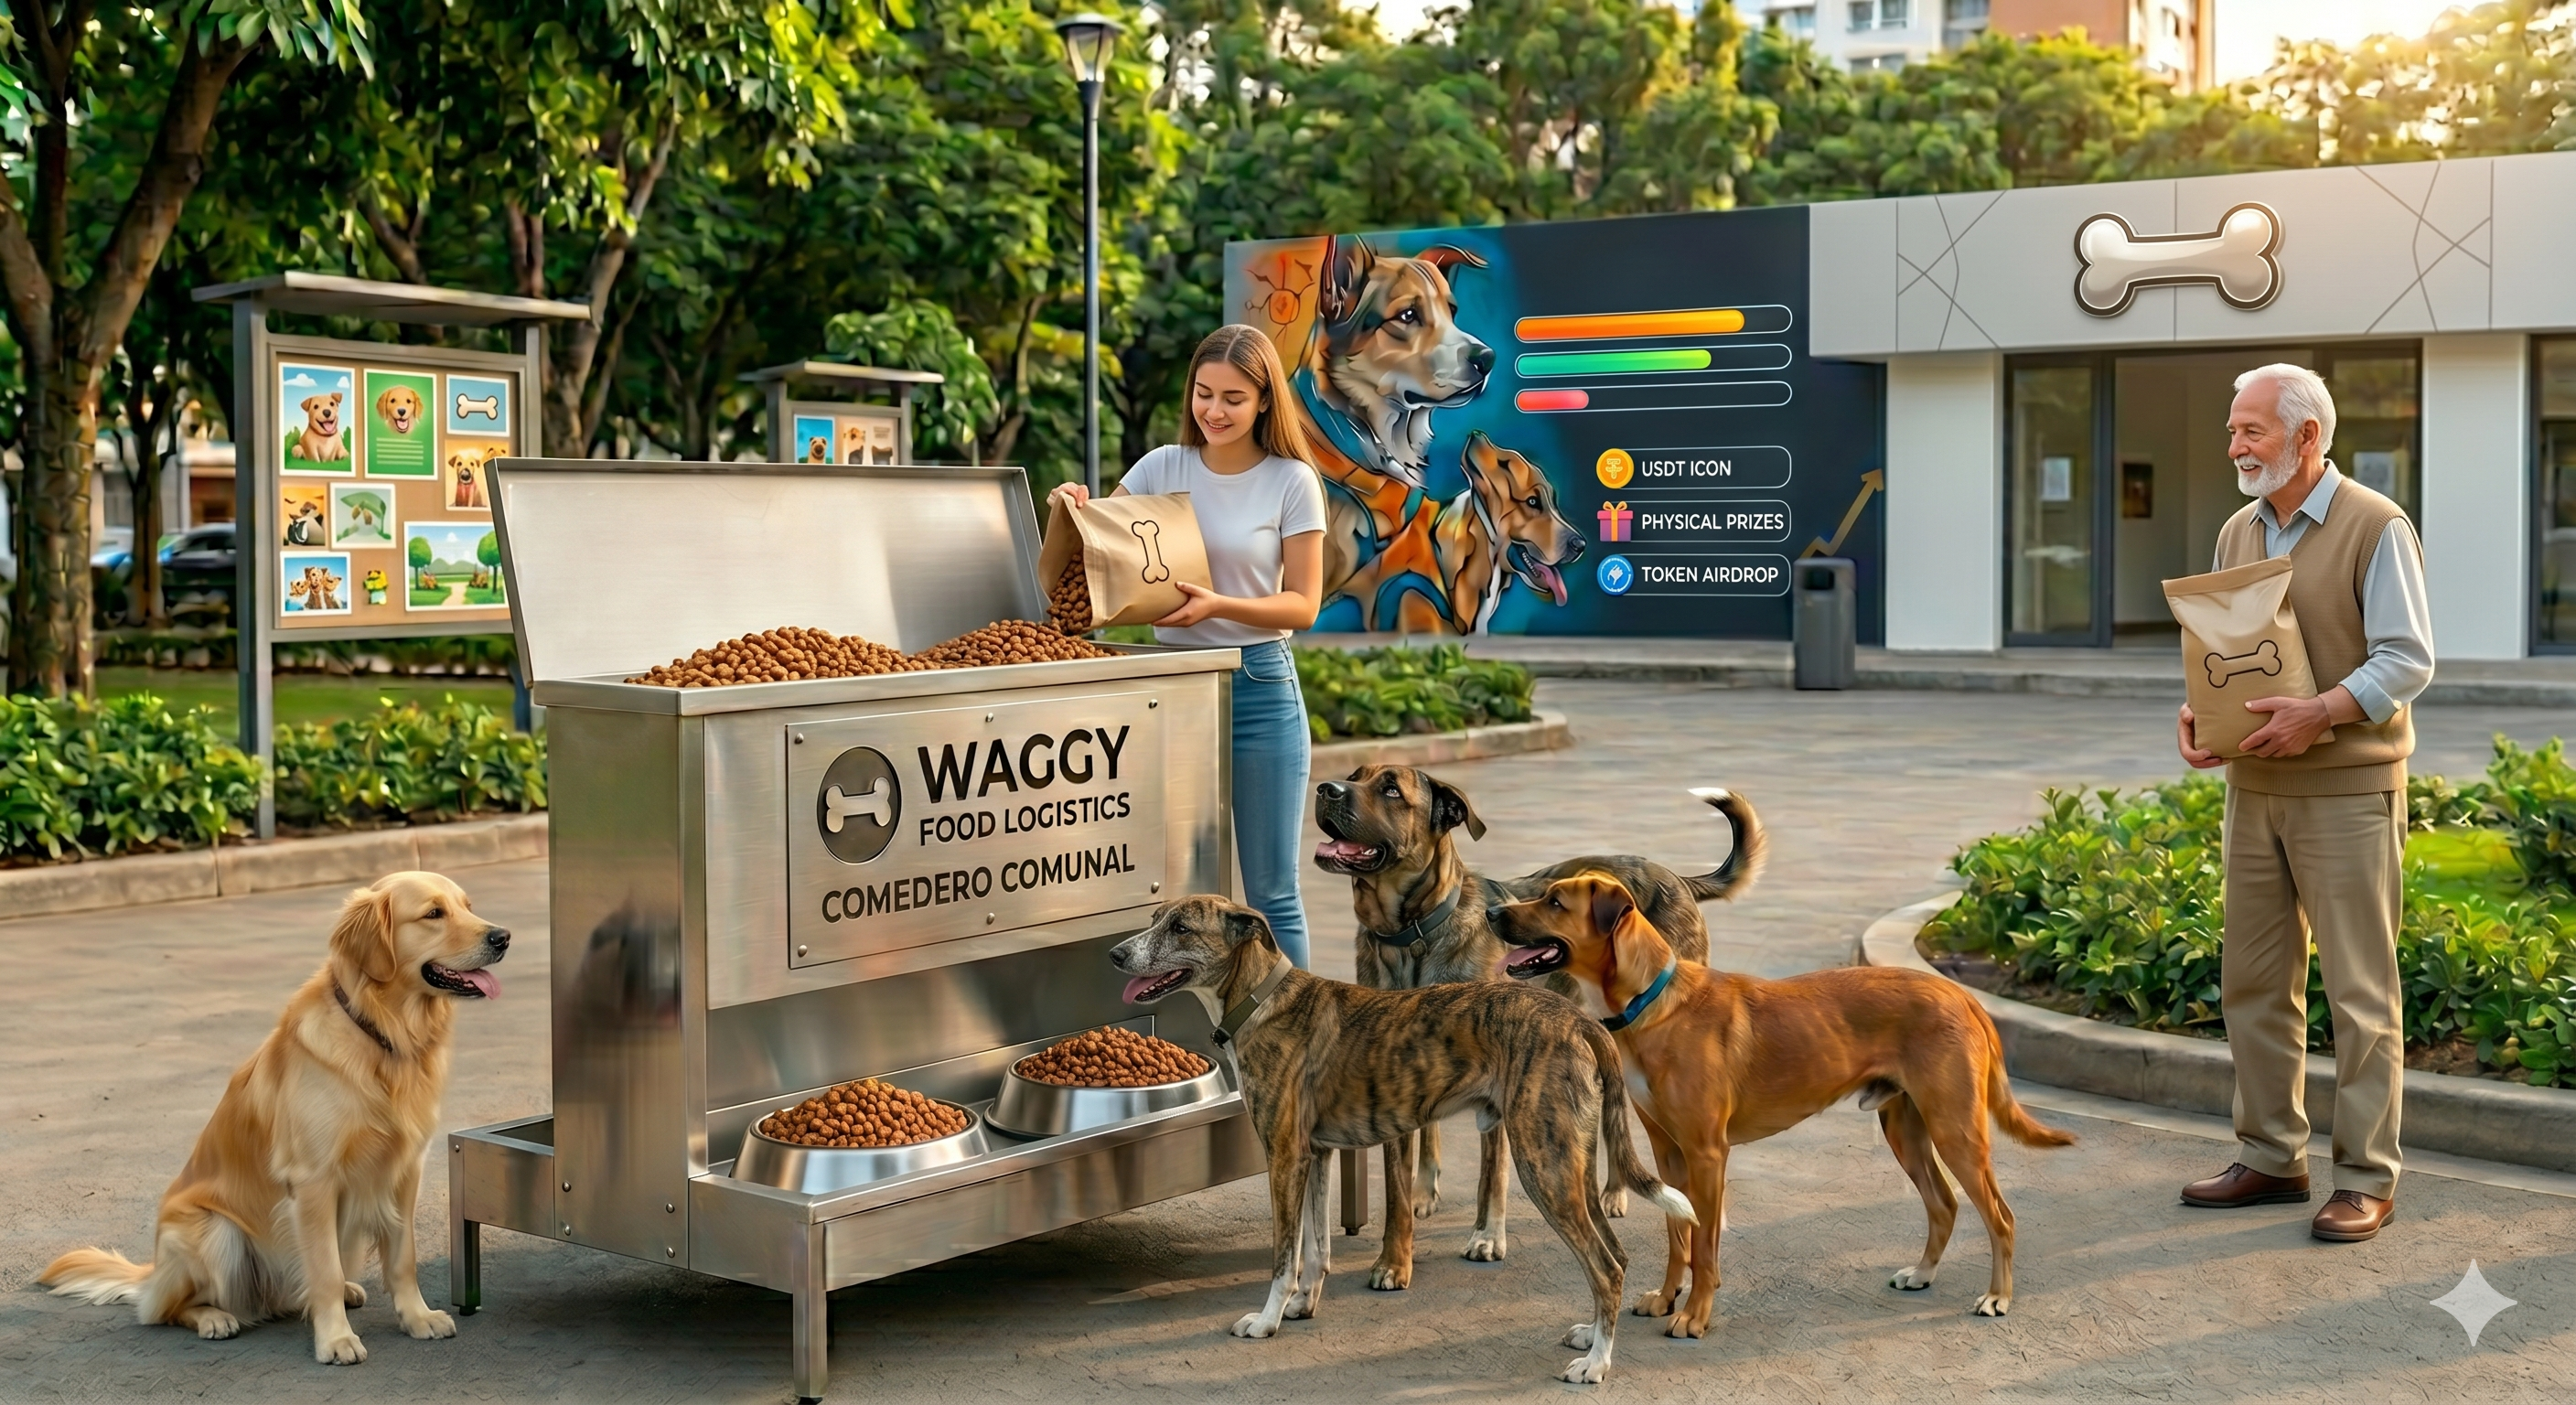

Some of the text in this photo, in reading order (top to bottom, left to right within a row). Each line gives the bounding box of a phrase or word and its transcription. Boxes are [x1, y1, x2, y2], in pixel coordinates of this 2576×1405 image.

[1642, 459, 1732, 477] USDT ICON
[1642, 513, 1785, 531] PHYSICAL PRIZES
[1641, 566, 1779, 584] TOKEN AIRDROP
[917, 724, 1131, 804] WAGGY
[919, 791, 1131, 847] FOOD LOGISTICS
[821, 842, 1135, 924] COMEDERO COMUNAL
